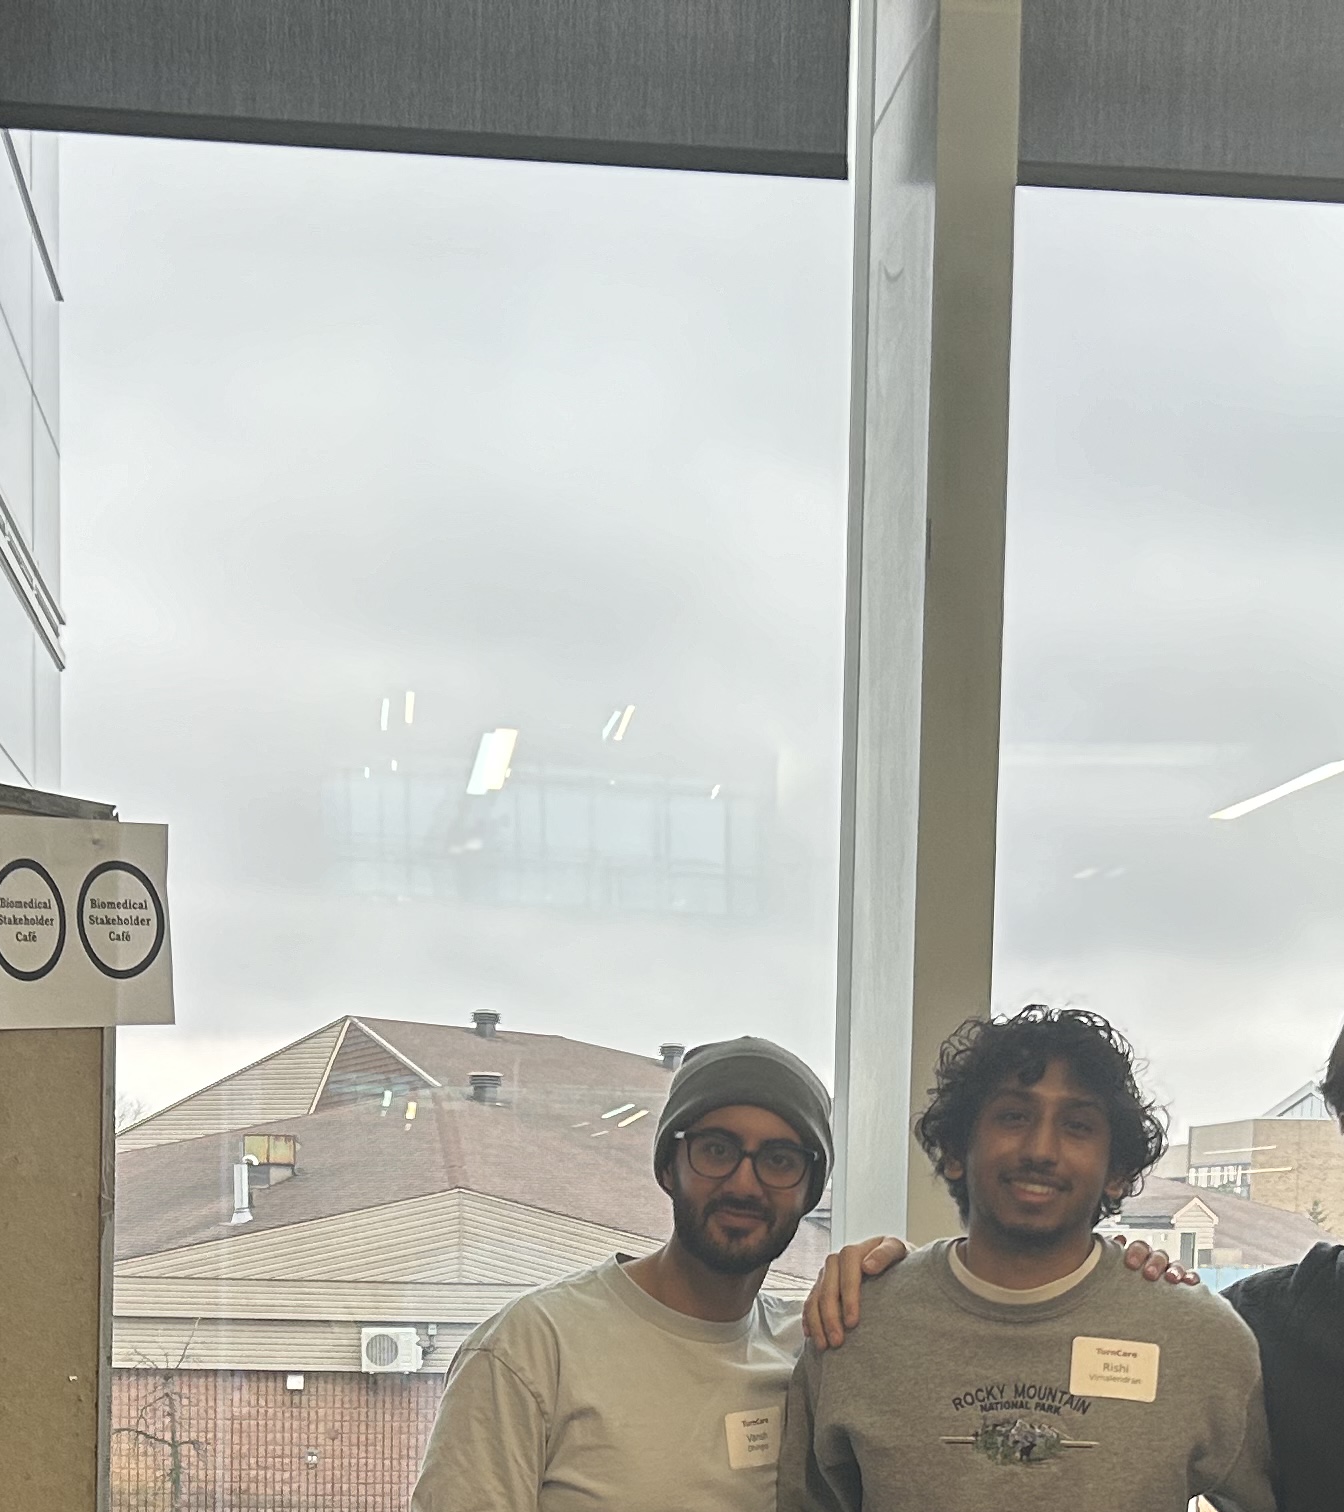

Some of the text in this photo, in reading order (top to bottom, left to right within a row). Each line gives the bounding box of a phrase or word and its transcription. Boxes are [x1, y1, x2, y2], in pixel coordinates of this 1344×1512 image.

[0, 898, 51, 910] Biomedical
[90, 899, 148, 911] Biomedical
[89, 915, 151, 927] Stakeholder
[16, 931, 37, 943] Café
[109, 931, 131, 943] Café
[1103, 1362, 1129, 1373] Rishi
[952, 1383, 1092, 1415] ROCKY MOUNTAIN
[980, 1401, 1063, 1415] NATIONAL PARK
